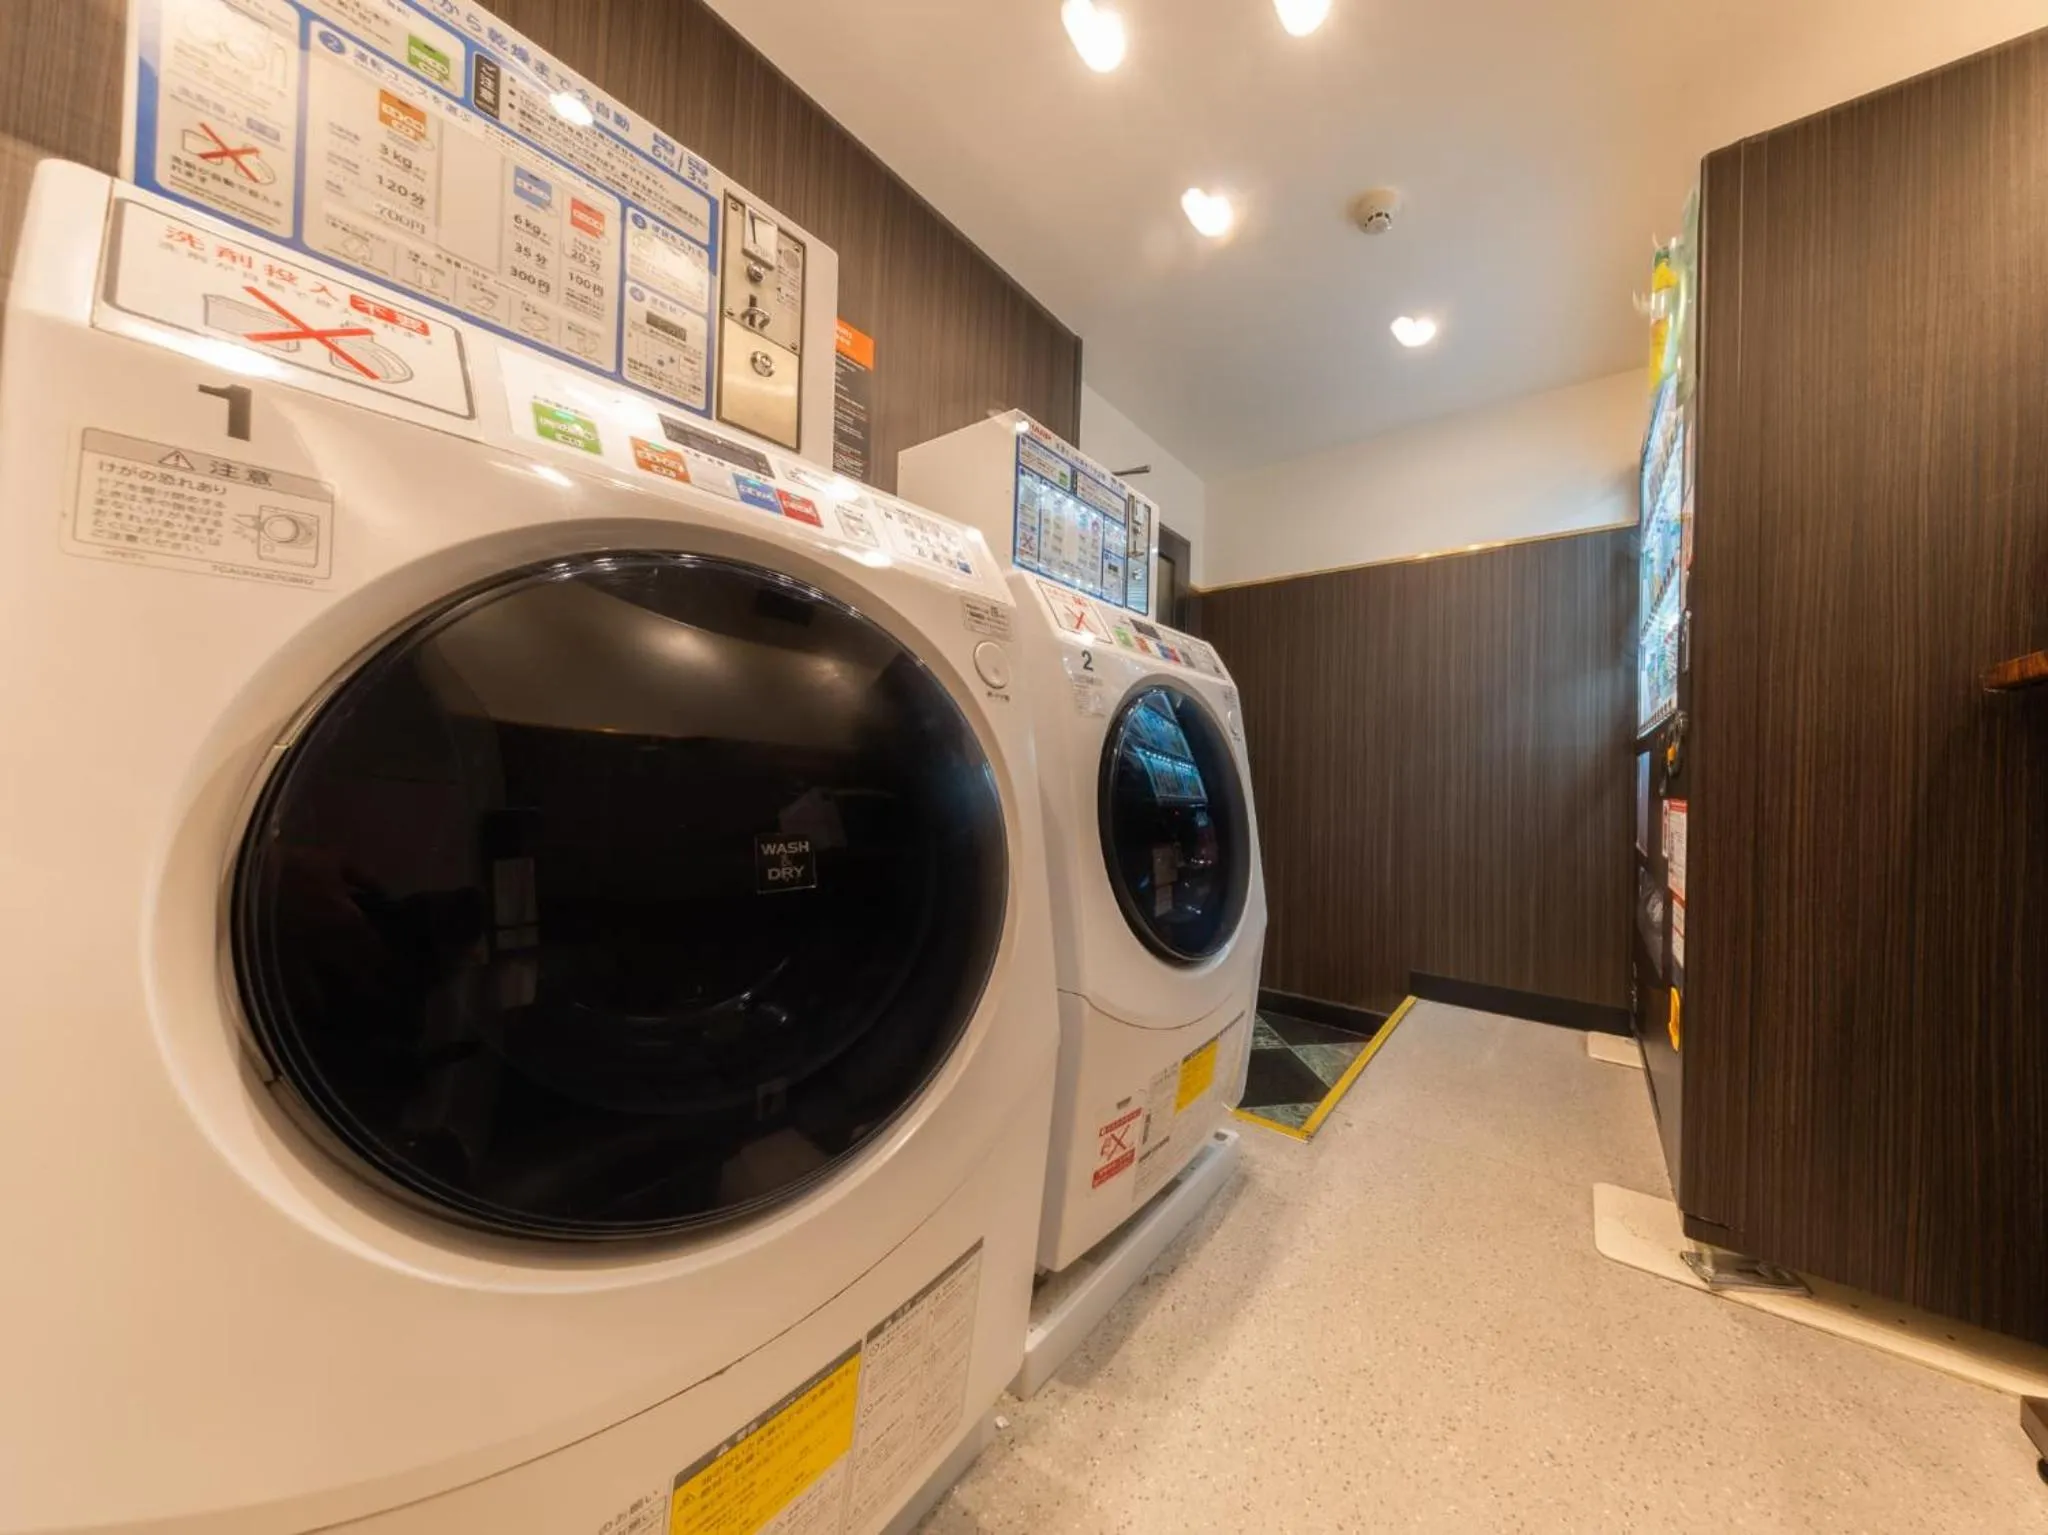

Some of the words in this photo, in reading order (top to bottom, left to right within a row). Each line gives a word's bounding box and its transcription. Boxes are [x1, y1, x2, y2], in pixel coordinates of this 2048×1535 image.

[164, 224, 339, 303] 洗剤投入
[510, 265, 551, 295] 300円
[198, 384, 252, 442] 1
[98, 461, 229, 496] けがの恐れあり
[208, 460, 273, 487] 注意
[1080, 650, 1094, 671] 2
[760, 840, 809, 856] WASH
[767, 865, 805, 881] DRY
